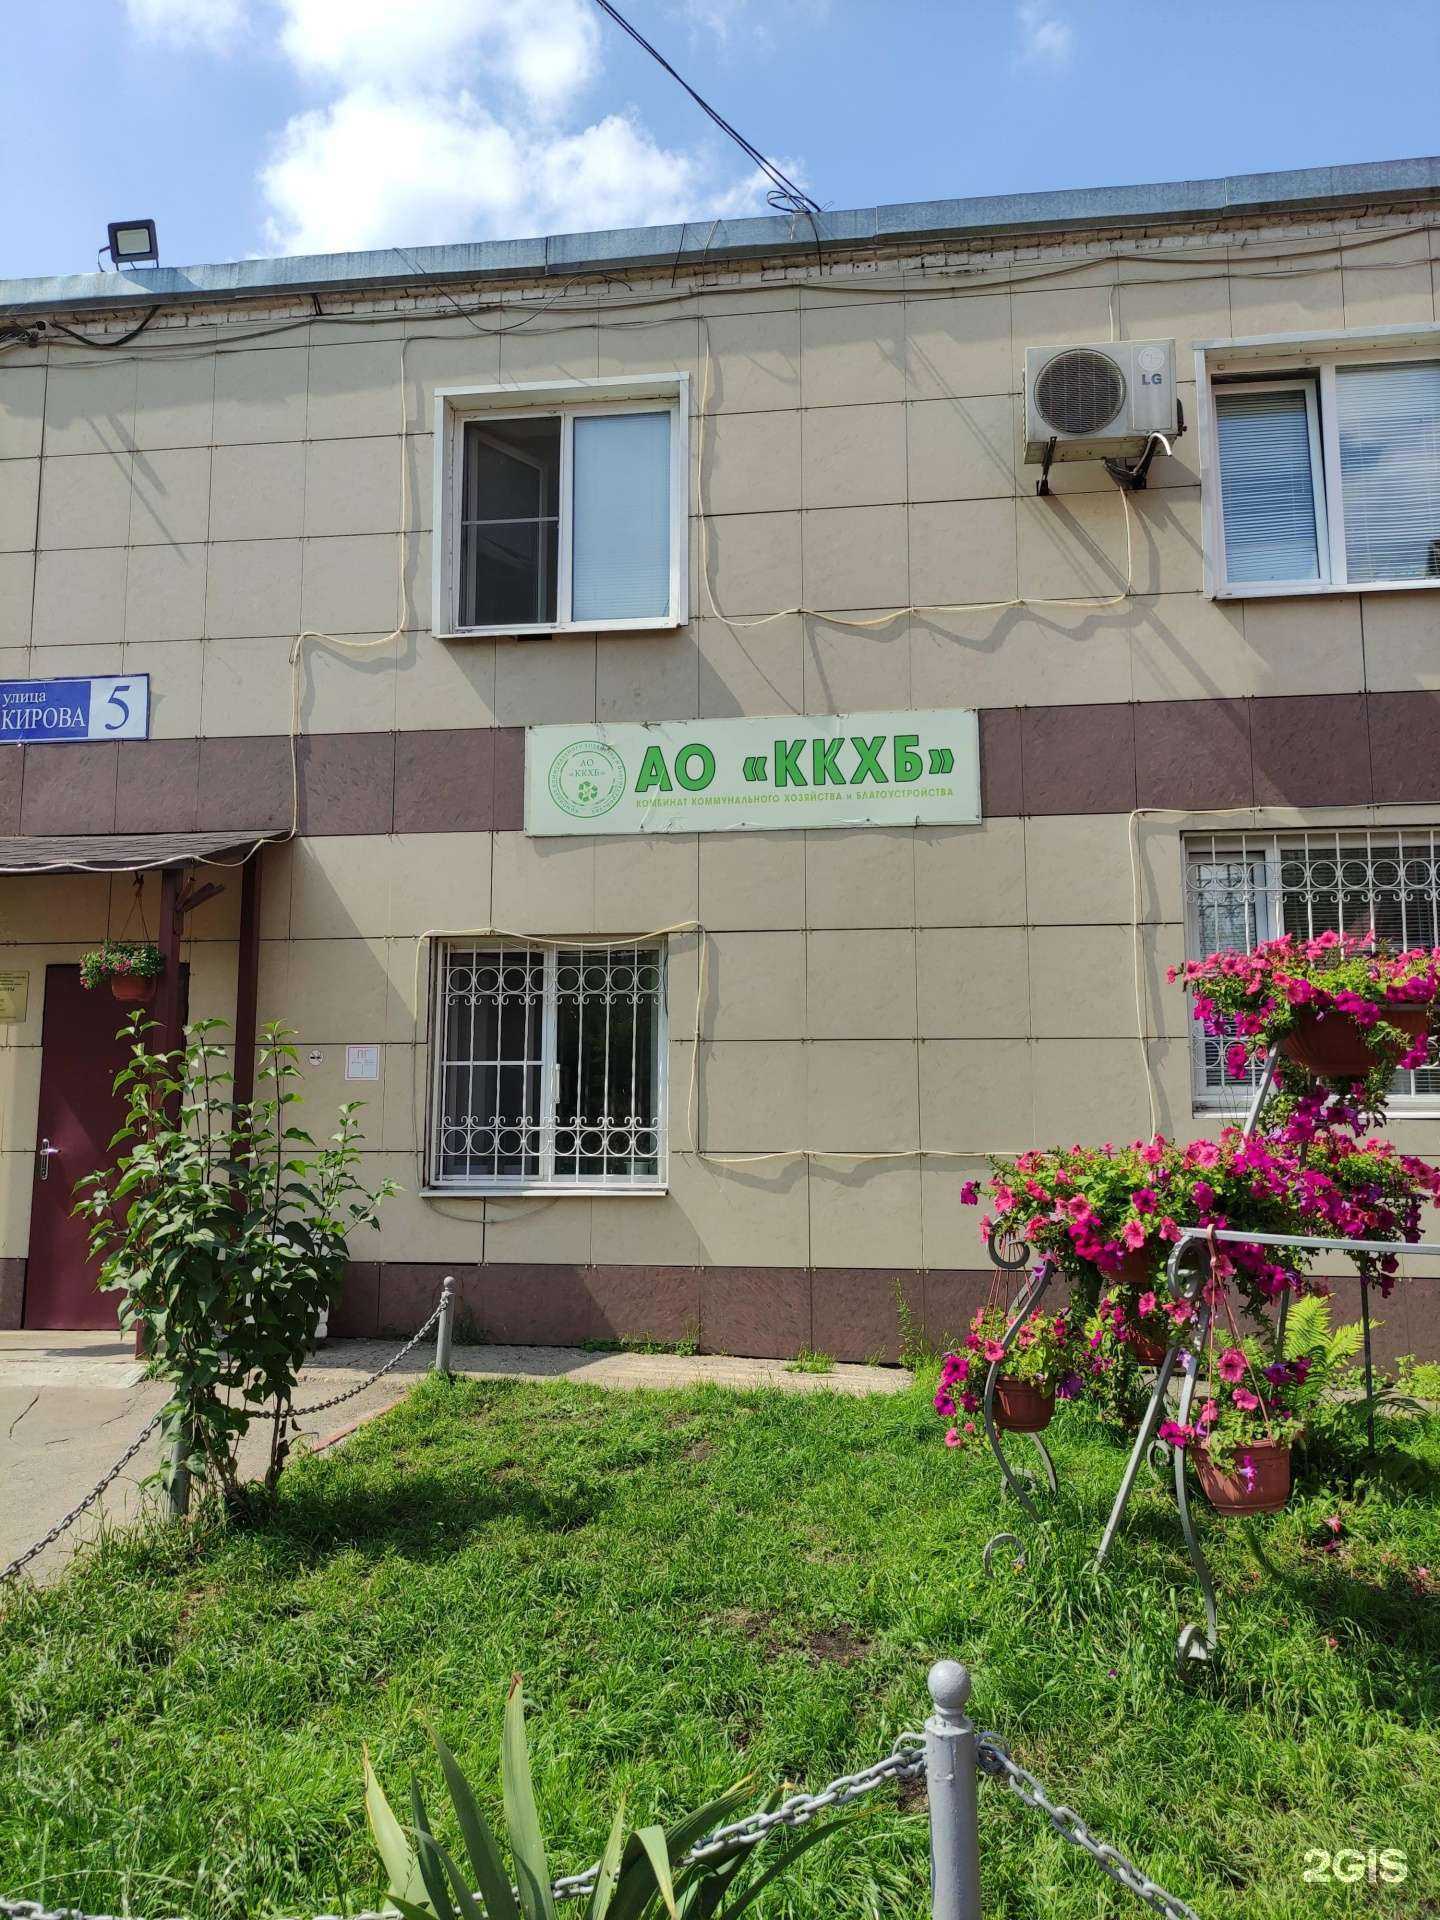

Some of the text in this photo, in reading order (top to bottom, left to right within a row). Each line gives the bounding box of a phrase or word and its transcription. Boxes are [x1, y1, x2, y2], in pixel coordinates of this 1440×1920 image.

[1141, 373, 1162, 386] LG
[2, 691, 46, 707] улица
[104, 685, 131, 730] 5
[1, 706, 86, 730] КИРОВА
[634, 743, 716, 792] АО
[742, 735, 955, 787] «ККХБ»
[636, 797, 688, 808] КОМБИНАТ
[691, 794, 780, 806] КОММУНАЛЬНОГО
[784, 791, 842, 802] ХОЗЯЙСТВА
[856, 787, 953, 800] БЛАГОУСТРОЙСТВА
